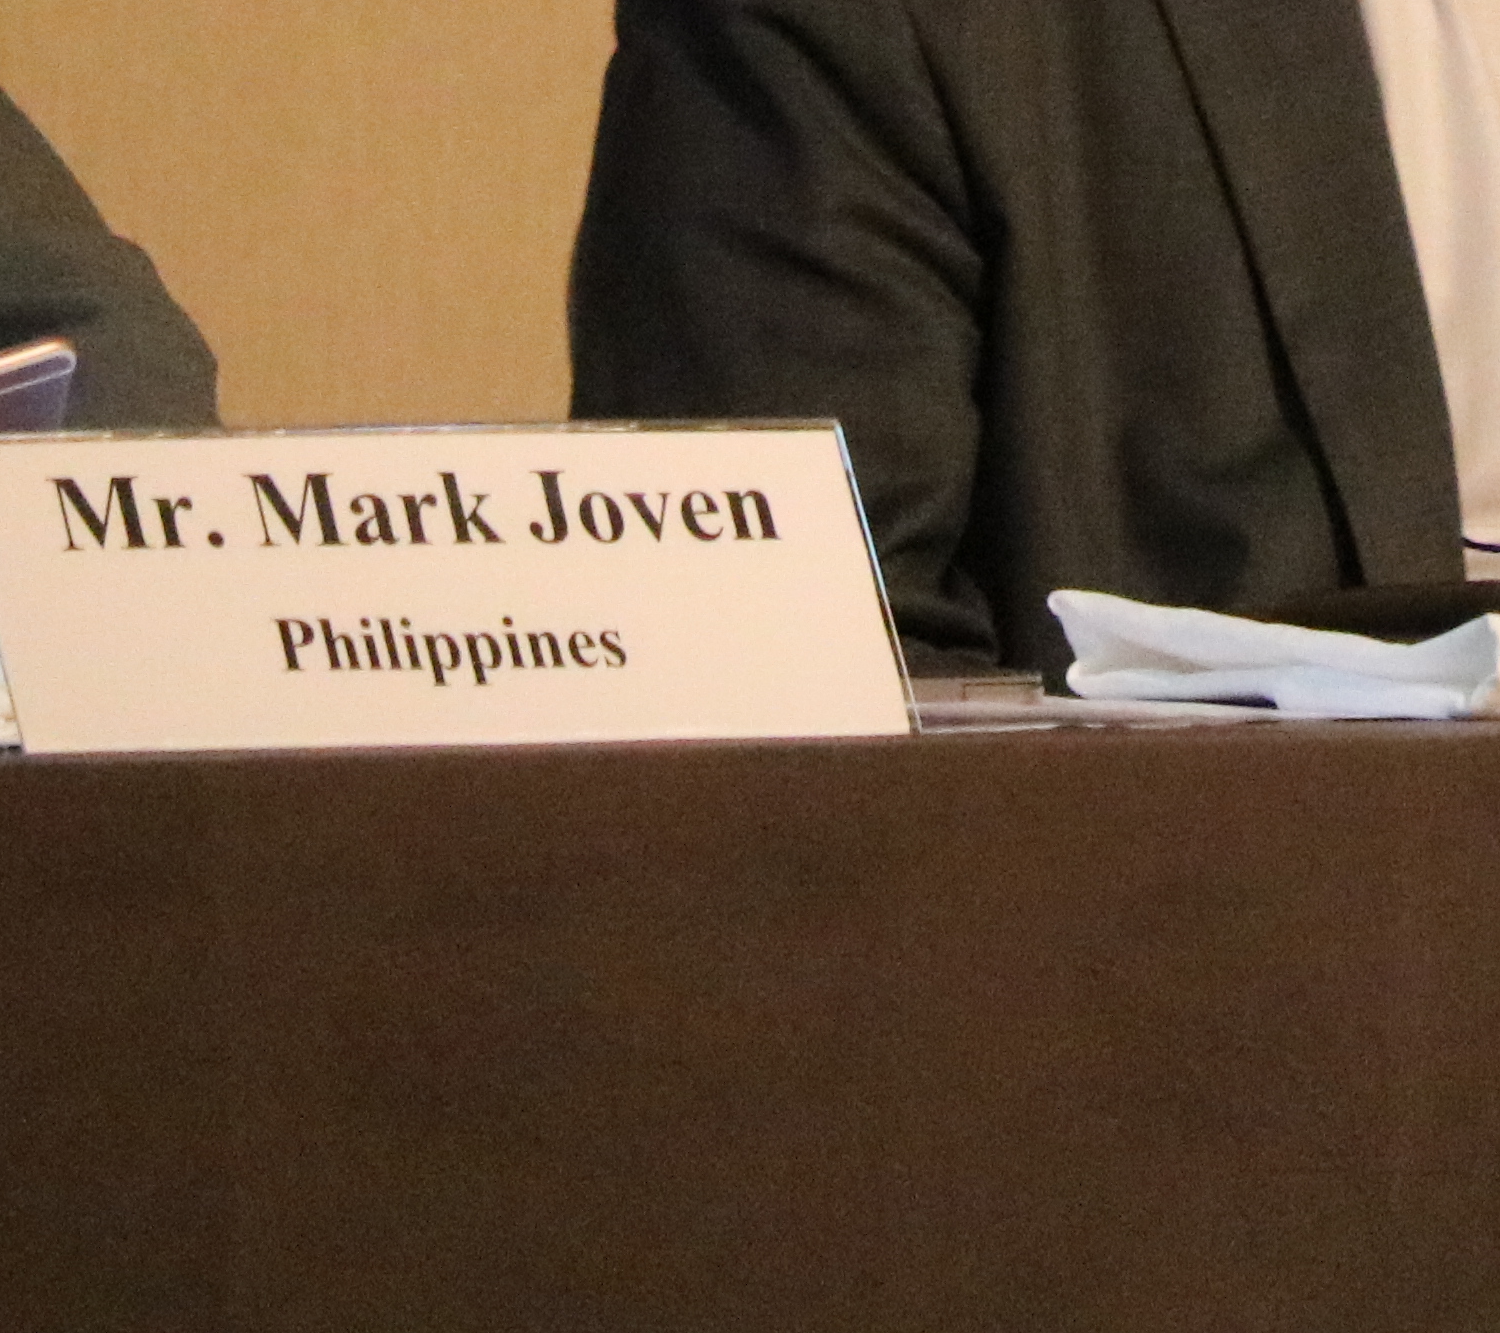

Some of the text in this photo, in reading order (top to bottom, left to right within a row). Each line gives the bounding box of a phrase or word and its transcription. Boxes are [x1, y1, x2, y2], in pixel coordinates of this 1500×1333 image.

[49, 469, 781, 550] Mr. Mark Joven
[273, 617, 628, 685] Philippines
